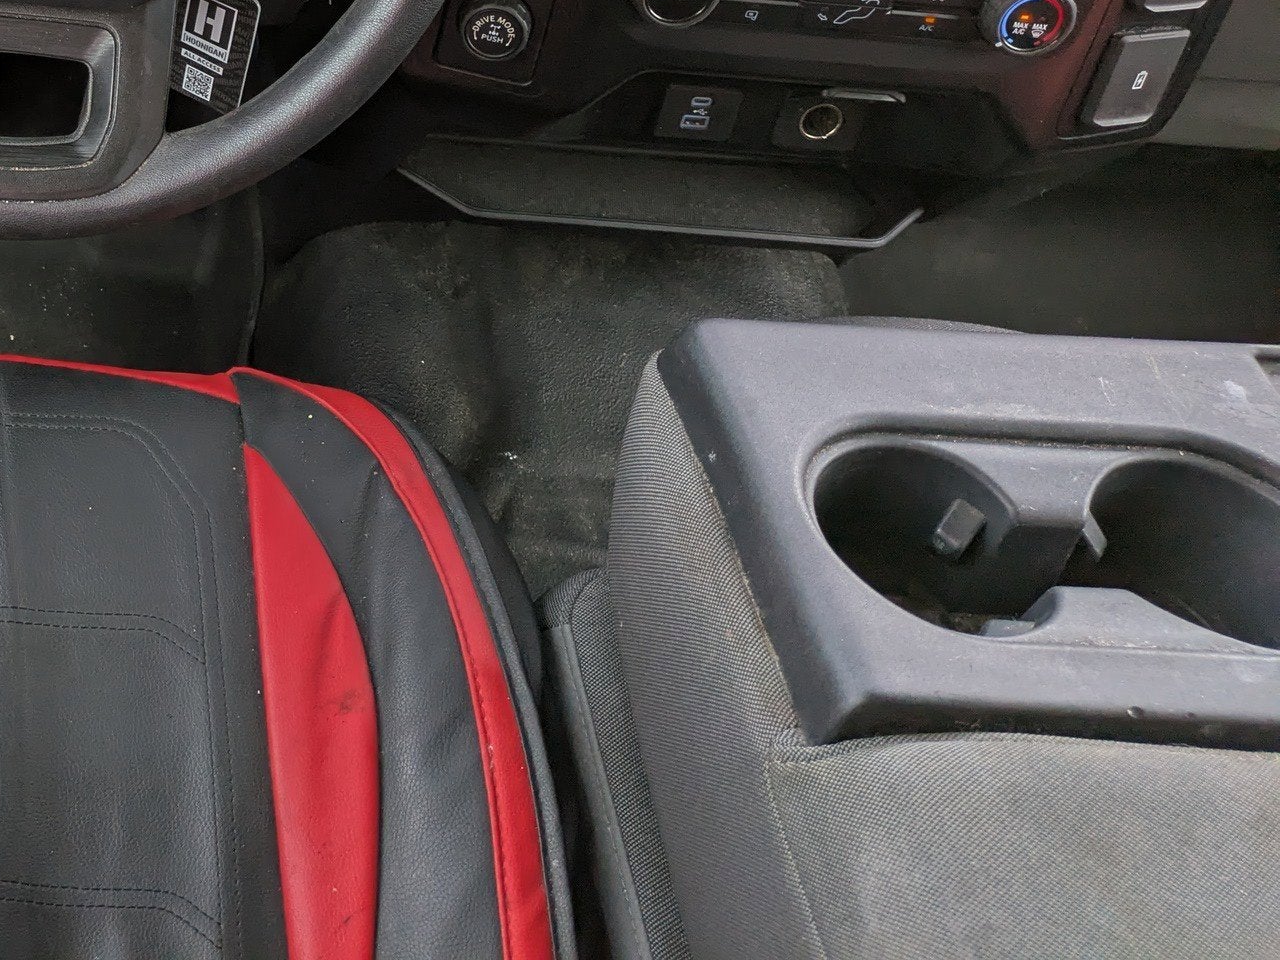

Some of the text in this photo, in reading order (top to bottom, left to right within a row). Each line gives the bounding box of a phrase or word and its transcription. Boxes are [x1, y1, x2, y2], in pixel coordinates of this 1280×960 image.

[194, 0, 226, 43] H
[472, 15, 515, 38] DRIVE MODE
[1032, 23, 1048, 31] MAX
[481, 33, 504, 44] PUSH
[183, 51, 221, 72] ALL ACCESS
